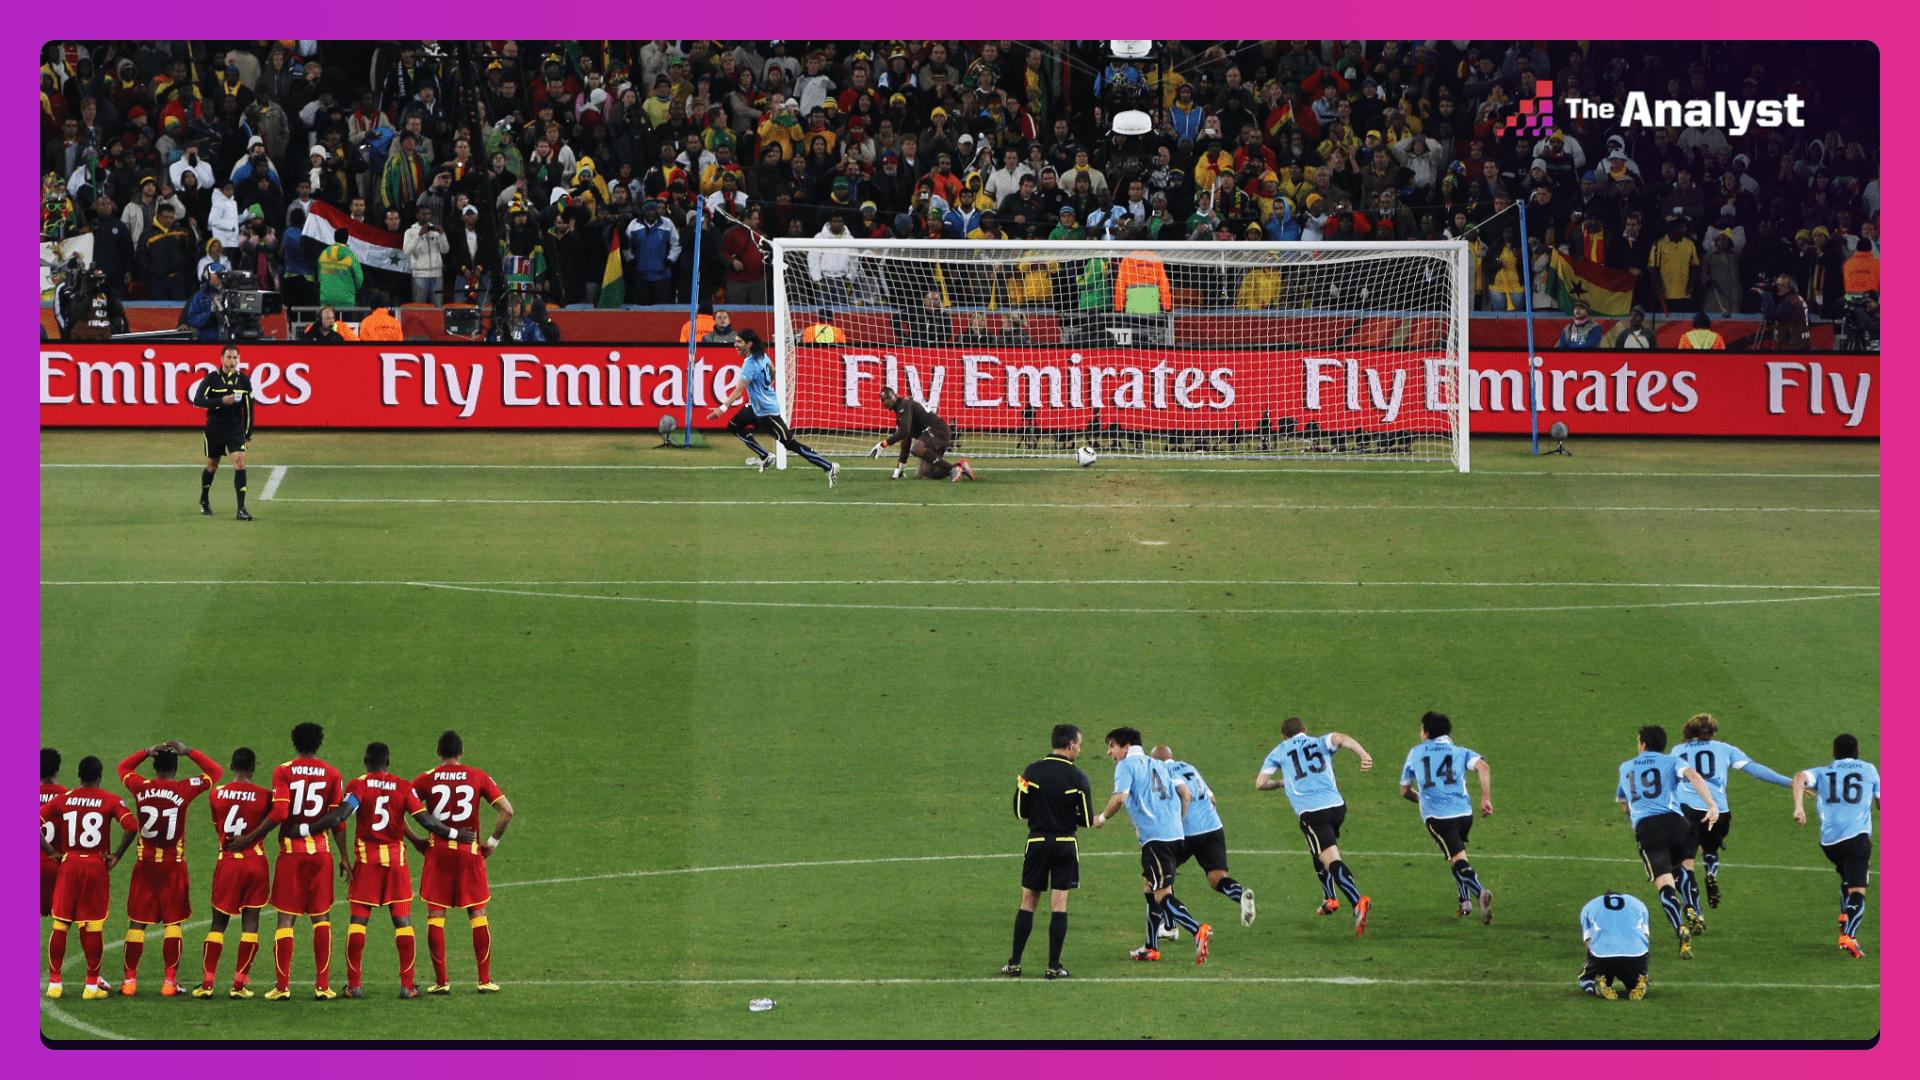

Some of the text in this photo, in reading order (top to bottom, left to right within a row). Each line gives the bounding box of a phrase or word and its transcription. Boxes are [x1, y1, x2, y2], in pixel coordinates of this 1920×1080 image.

[40, 348, 312, 405] Emires
[379, 350, 744, 418] Fly Emirate
[842, 352, 1236, 413] Fly Emirates
[1303, 356, 1699, 423] Fly Emirates
[1765, 361, 1872, 427] Fly
[291, 766, 326, 777] VORSAH
[434, 772, 467, 781] PRINCE
[1287, 743, 1326, 781] 15
[1420, 754, 1457, 789] 14
[65, 797, 103, 808] ADIYIAH
[217, 789, 257, 802] PANTSIL
[290, 779, 327, 818] 15
[1151, 768, 1170, 801] 4
[1626, 767, 1662, 804] 19
[1825, 771, 1863, 805] 16
[224, 804, 248, 836] 4
[371, 796, 390, 832] 5
[431, 784, 475, 822] 23
[62, 810, 104, 849] 18
[140, 805, 178, 840] 21
